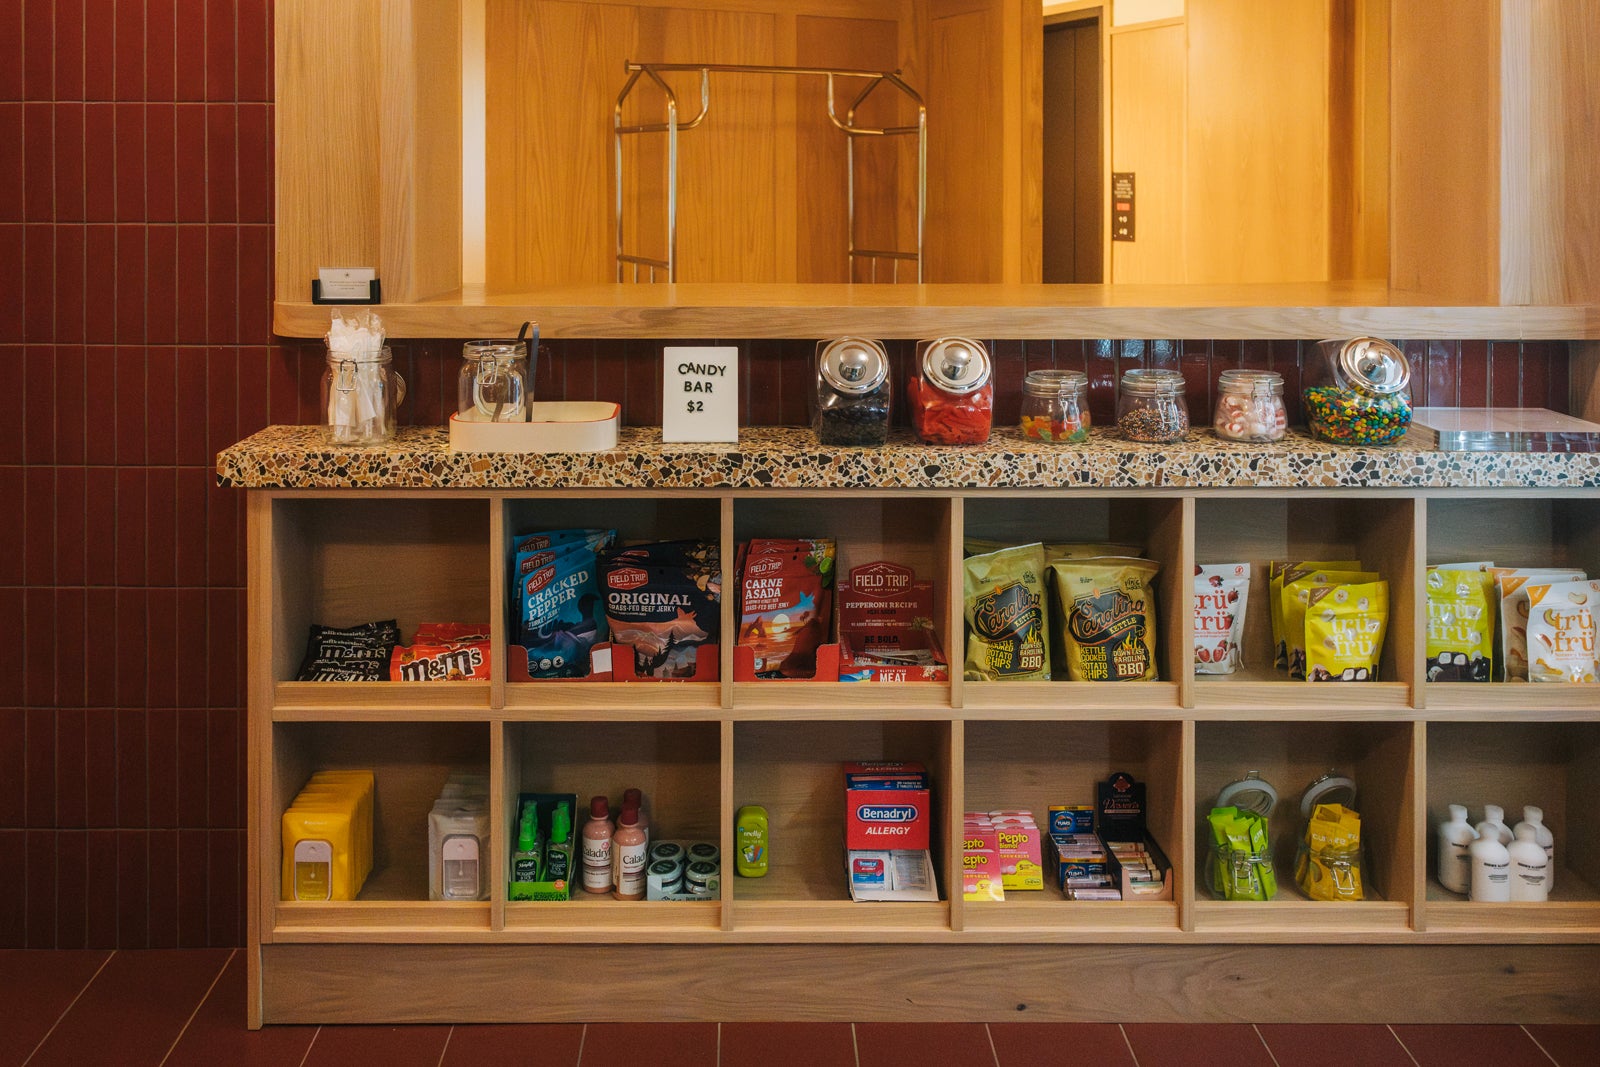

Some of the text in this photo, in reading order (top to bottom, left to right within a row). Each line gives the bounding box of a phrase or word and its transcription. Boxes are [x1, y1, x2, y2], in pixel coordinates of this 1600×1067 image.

[678, 362, 726, 376] CANDY
[684, 381, 713, 393] BAR
[687, 400, 704, 414] $2
[750, 562, 782, 574] FIELD TRIP
[528, 567, 555, 592] FIELD TRIP
[609, 573, 646, 584] FIELD TRIP
[745, 578, 783, 589] CARNE
[855, 575, 884, 587] FIELD
[885, 575, 909, 587] TRIP
[527, 570, 588, 609] CRACKED
[745, 588, 781, 600] ASADA
[528, 588, 576, 622] PEPPER
[608, 592, 692, 606] ORIGINAL
[608, 603, 640, 612] GRASS-FED
[656, 605, 676, 613] JERKY
[975, 589, 1041, 638] Carolina
[1069, 594, 1146, 640] Carolina
[1554, 609, 1594, 631] trü
[1109, 617, 1137, 634] KETTLE
[1333, 634, 1374, 657] frü
[1553, 631, 1595, 652] frü
[986, 648, 1013, 661] POTATO
[1081, 646, 1106, 656] KETTLE
[401, 648, 483, 681] m&m's
[984, 656, 1012, 669] CHIPS
[1021, 655, 1042, 669] BBQ
[1081, 654, 1107, 662] COOKED
[1081, 661, 1108, 671] POTATO
[1118, 662, 1144, 676] BBQ
[880, 672, 906, 682] MEAT
[1082, 669, 1108, 679] CHIPS
[863, 808, 911, 821] Benadryl
[865, 827, 911, 835] ALLERGY
[964, 839, 985, 850] epto
[999, 832, 1029, 845] Pepto
[964, 855, 988, 867] epto
